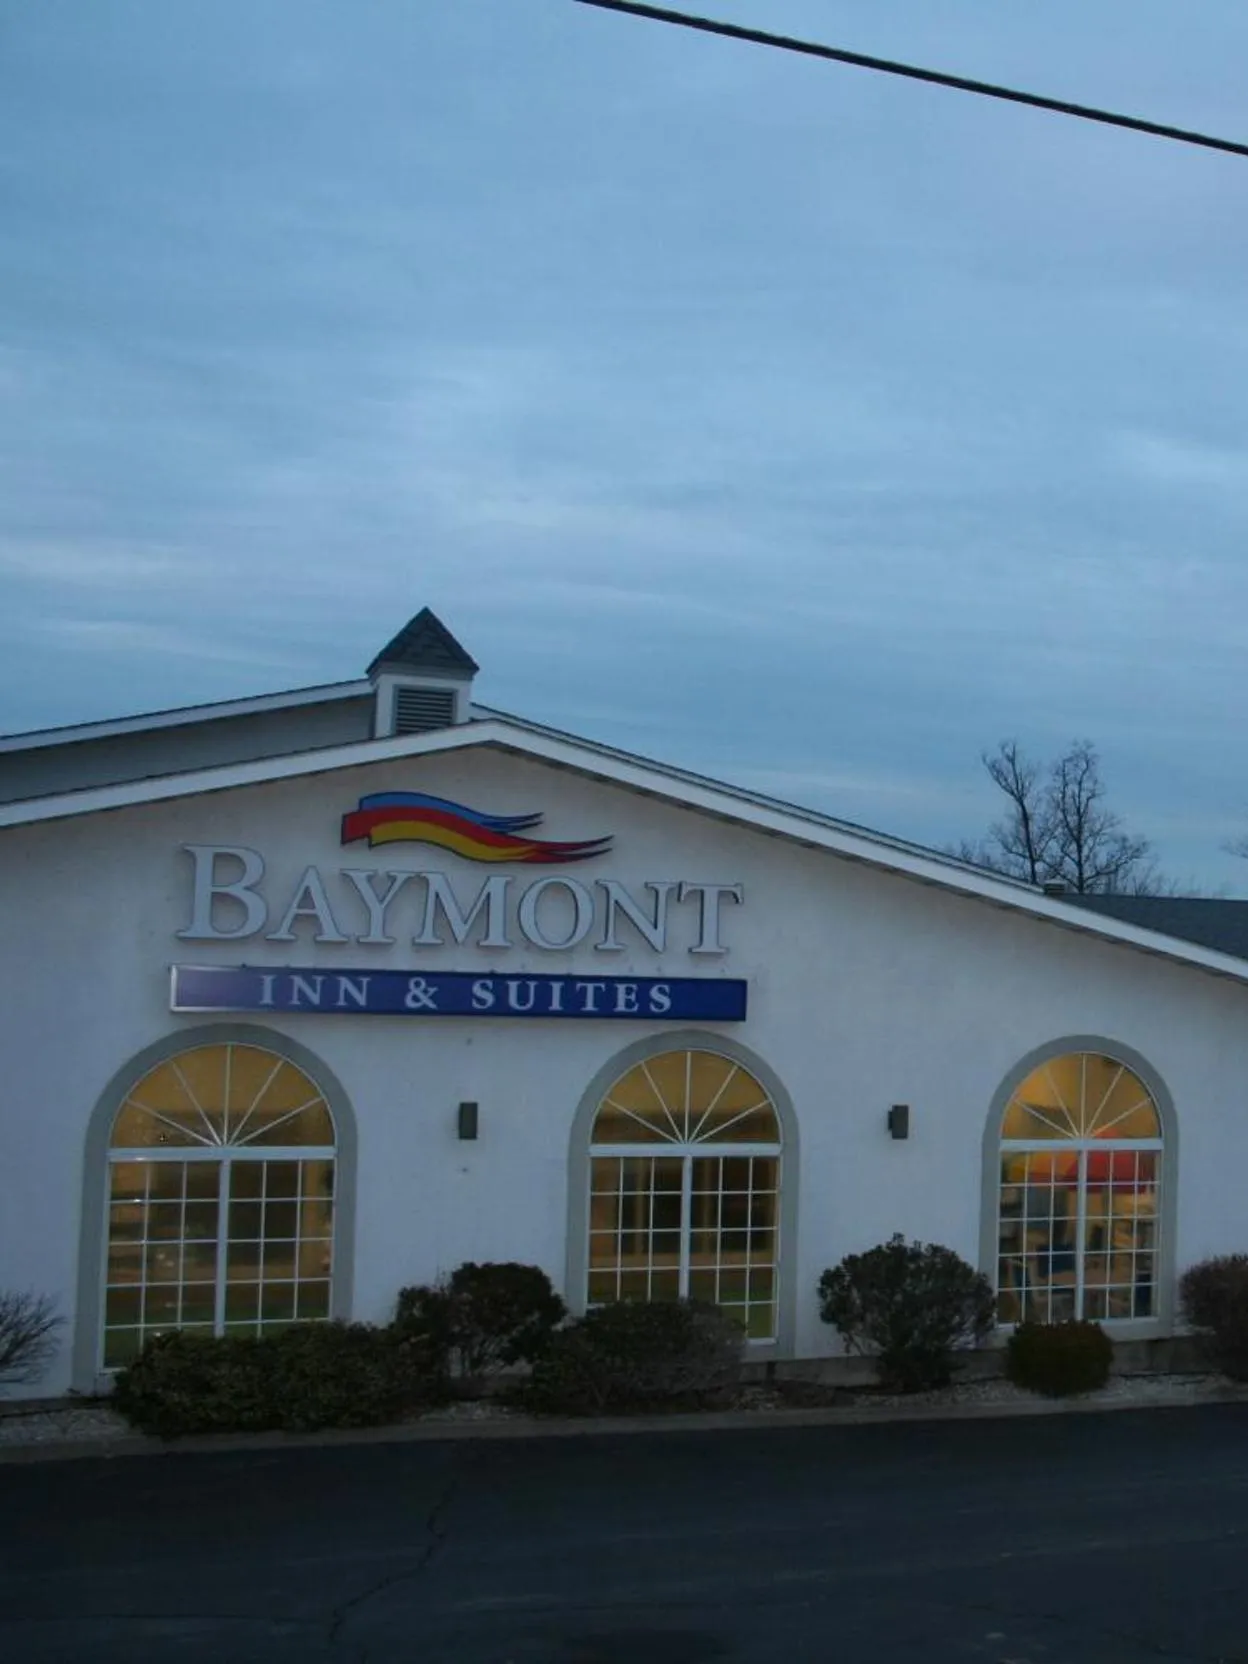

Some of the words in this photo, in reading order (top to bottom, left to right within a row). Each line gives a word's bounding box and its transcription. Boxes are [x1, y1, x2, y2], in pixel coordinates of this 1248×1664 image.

[177, 843, 745, 954] BAYMONT
[260, 974, 372, 1006] INN
[404, 978, 438, 1010] &
[471, 980, 671, 1012] SUITES
